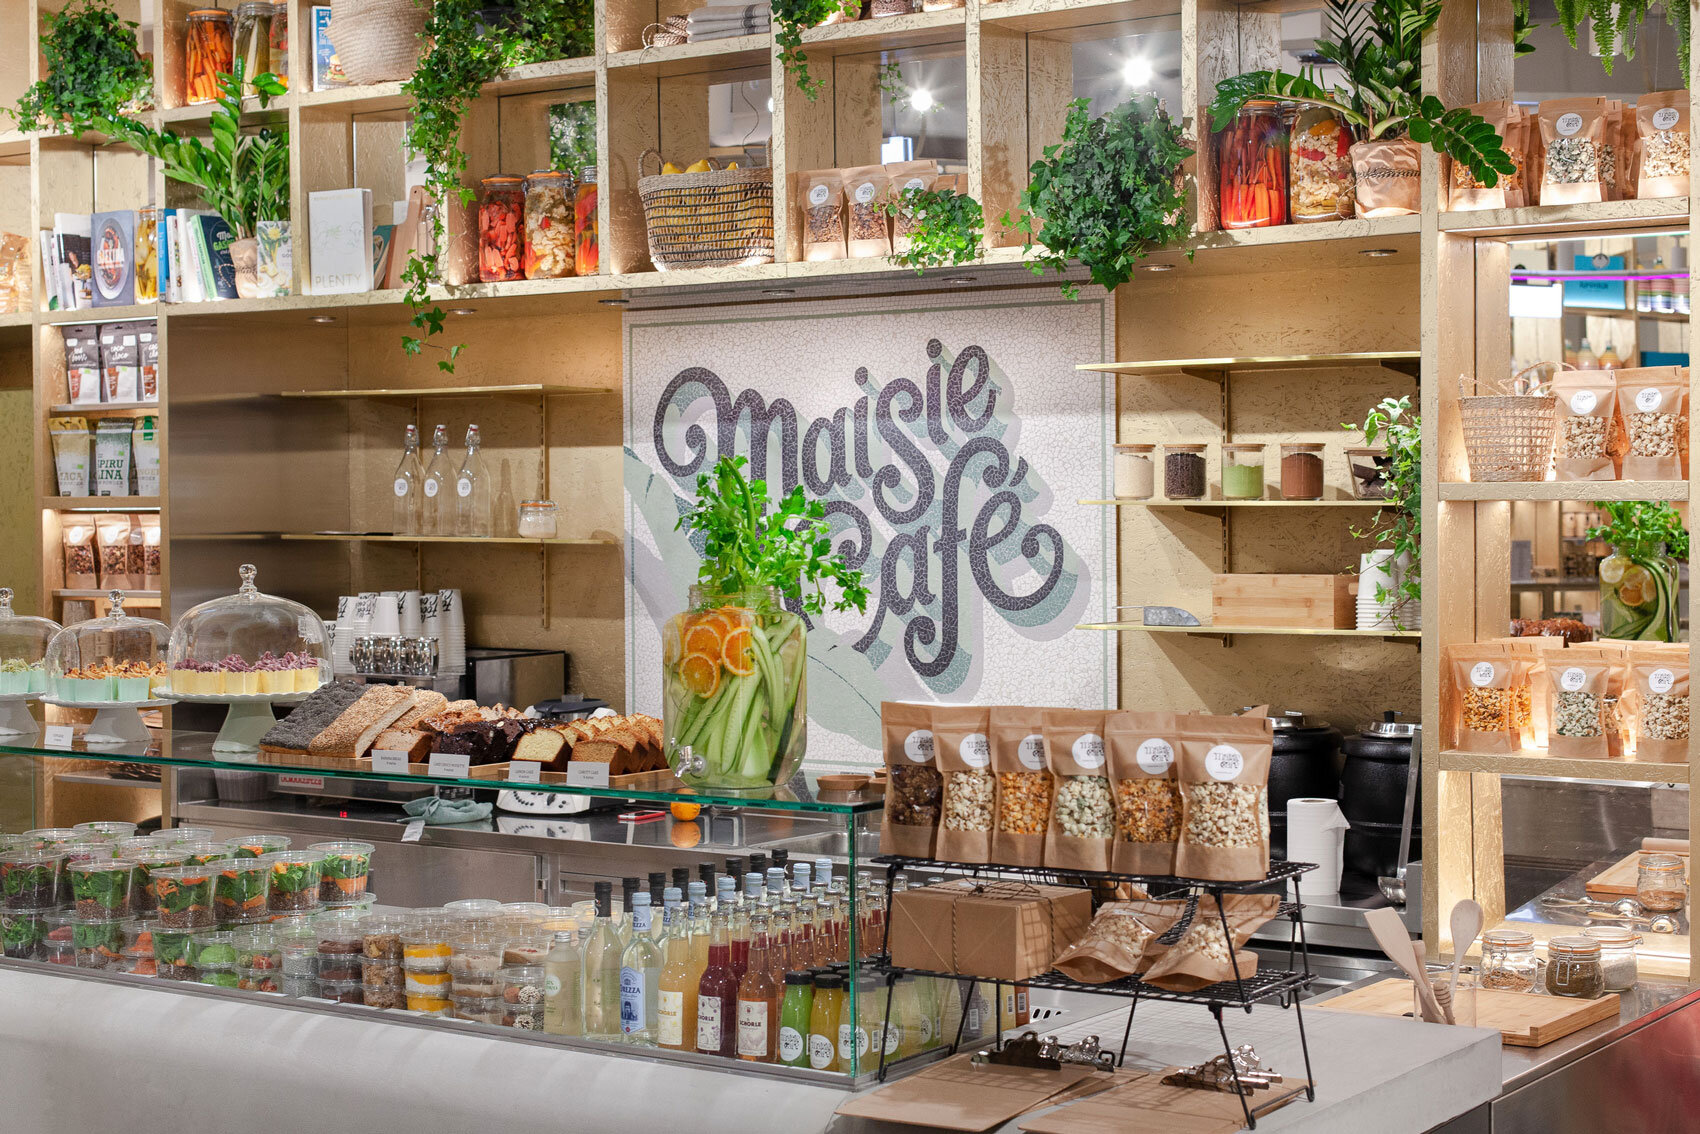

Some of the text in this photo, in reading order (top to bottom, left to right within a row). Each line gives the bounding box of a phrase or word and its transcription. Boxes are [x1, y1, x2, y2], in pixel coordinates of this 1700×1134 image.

[315, 274, 361, 288] PLENTY
[98, 460, 123, 468] PIRU
[98, 470, 123, 480] INA
